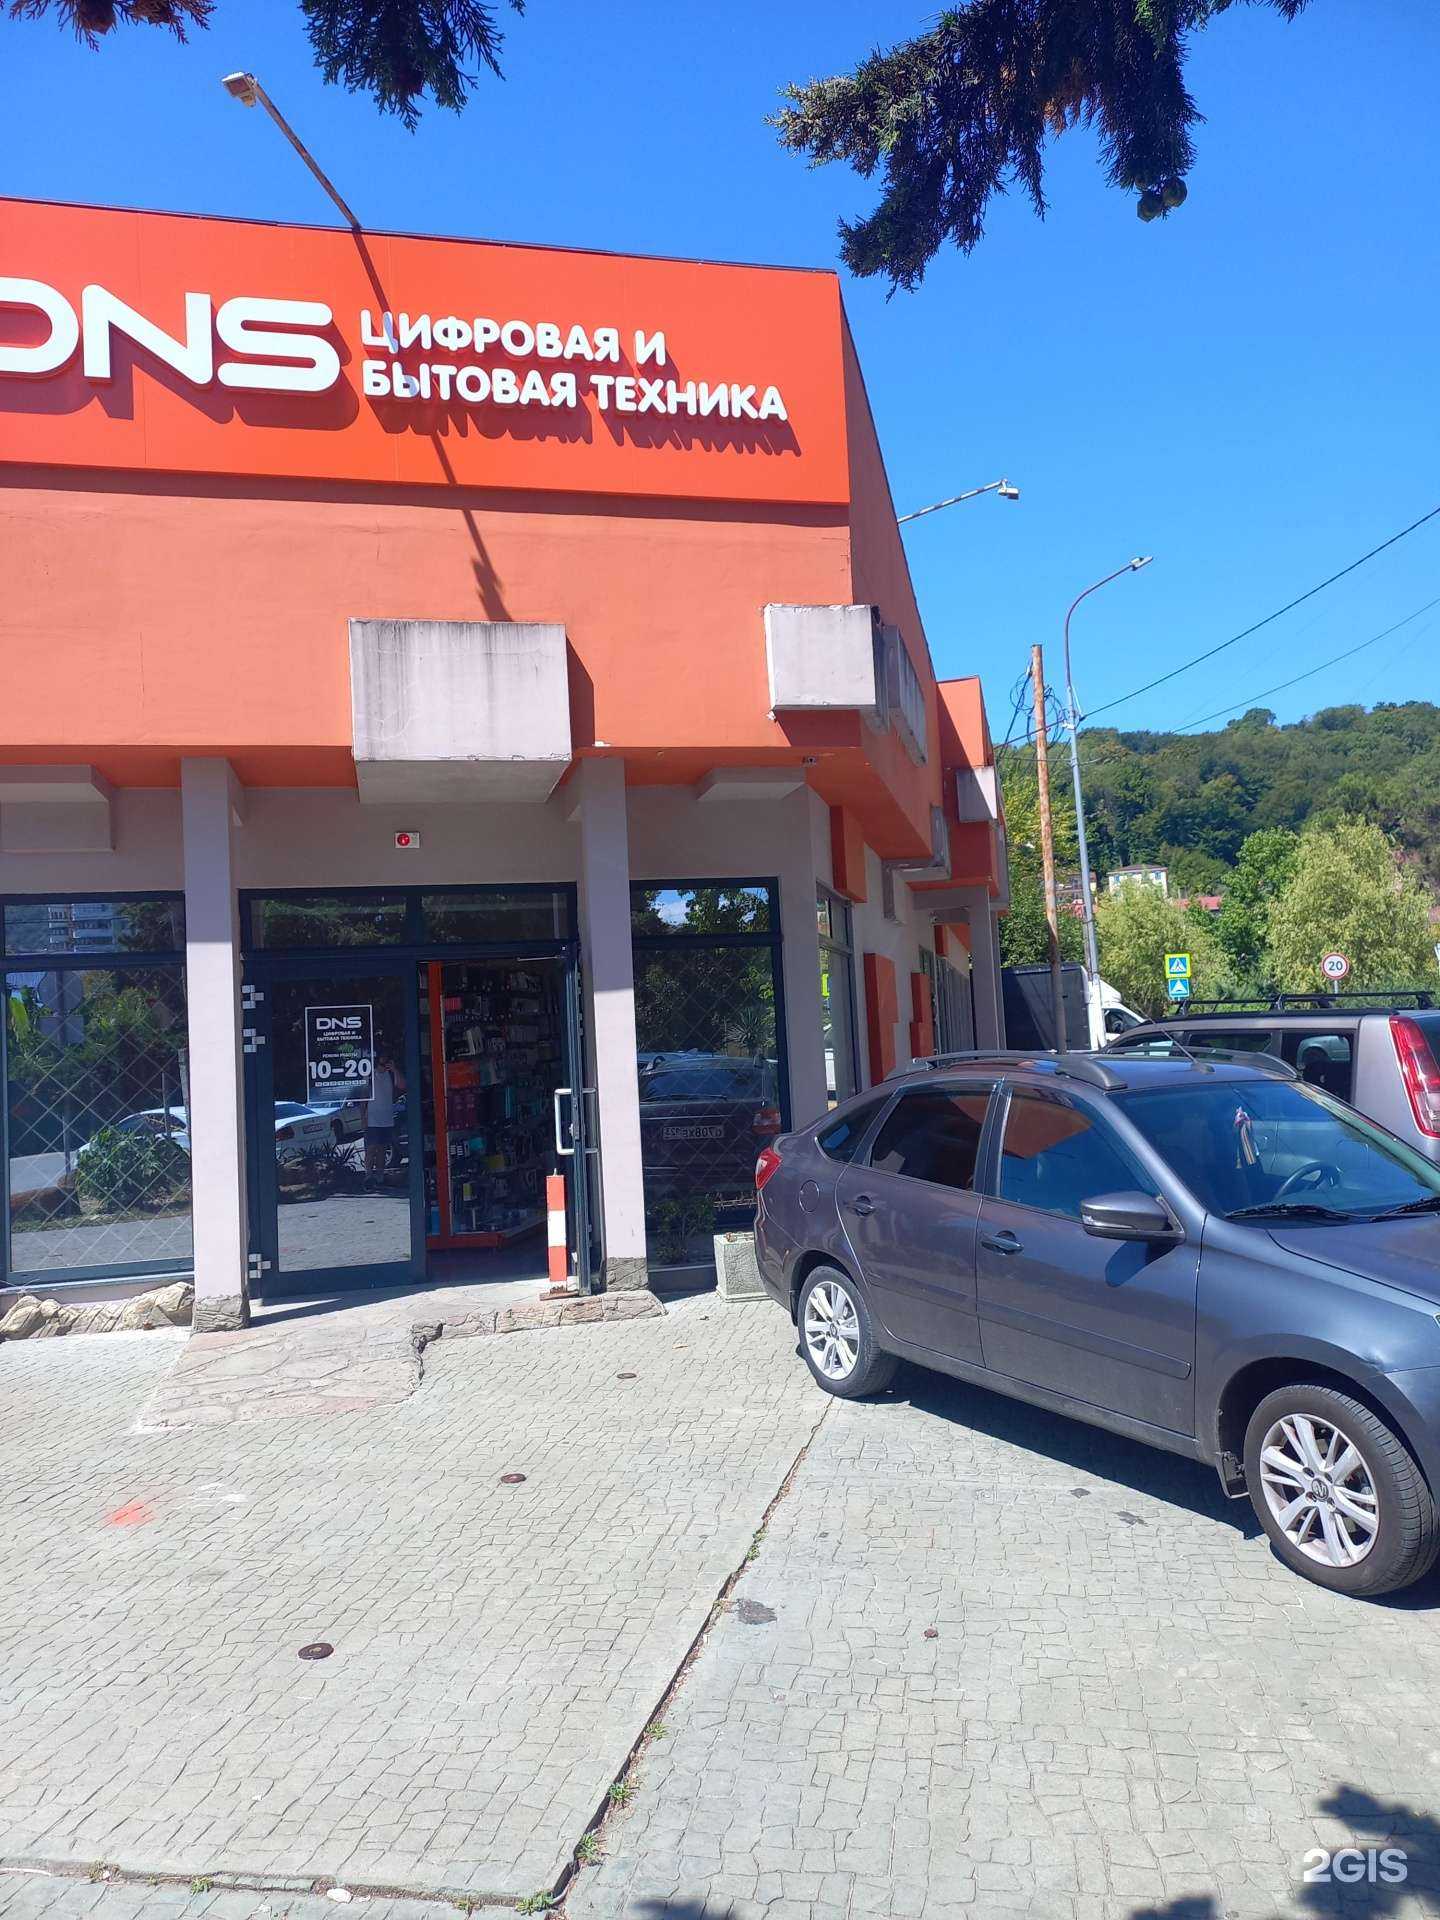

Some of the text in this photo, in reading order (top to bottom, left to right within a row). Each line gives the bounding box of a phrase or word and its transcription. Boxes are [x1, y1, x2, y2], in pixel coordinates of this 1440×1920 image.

[0, 276, 340, 392] DNS
[360, 309, 666, 366] ЦИФРОВАЯ И
[362, 359, 788, 421] БЫТОВАЯ ТЕХНИКА
[1328, 961, 1343, 971] 20
[316, 1016, 362, 1030] DNS
[309, 1059, 372, 1080] 10-20
